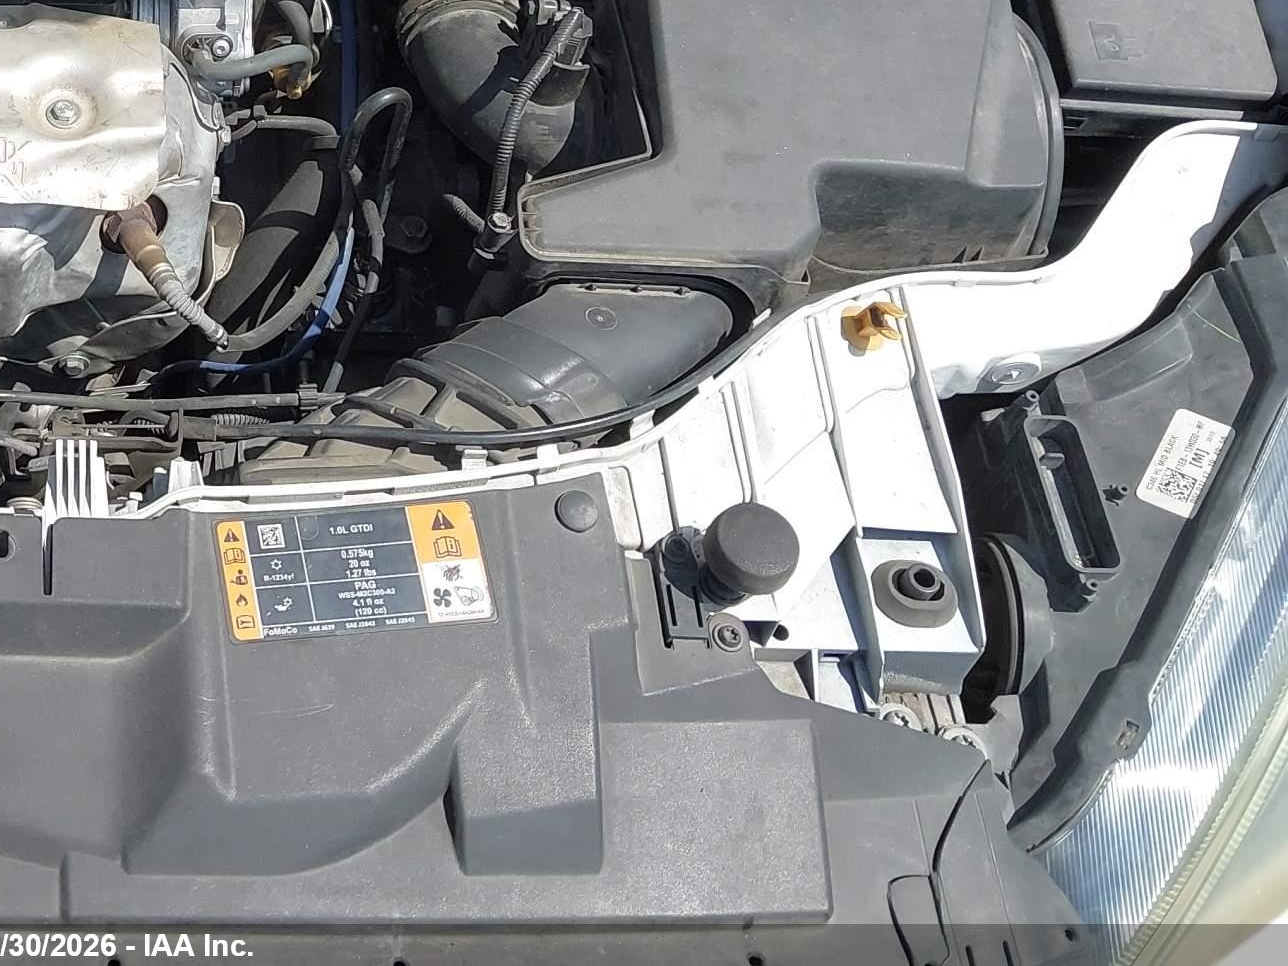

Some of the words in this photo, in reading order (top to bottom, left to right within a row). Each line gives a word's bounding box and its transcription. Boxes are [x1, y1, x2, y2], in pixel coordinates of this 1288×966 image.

[1164, 435, 1178, 455] BLACK
[329, 526, 349, 535] 1.0L
[340, 549, 374, 558] 0.575kg
[348, 559, 359, 568] 20
[263, 573, 295, 581] R-1234yf
[346, 569, 362, 578] 1.27
[363, 568, 376, 576] lbs
[354, 581, 376, 590] PAG
[352, 599, 365, 607] 4.1
[366, 598, 372, 606] fl
[354, 607, 372, 617] (120
[374, 606, 387, 615] cc)
[345, 621, 357, 629] SAE
[263, 626, 297, 636] FoMoCo
